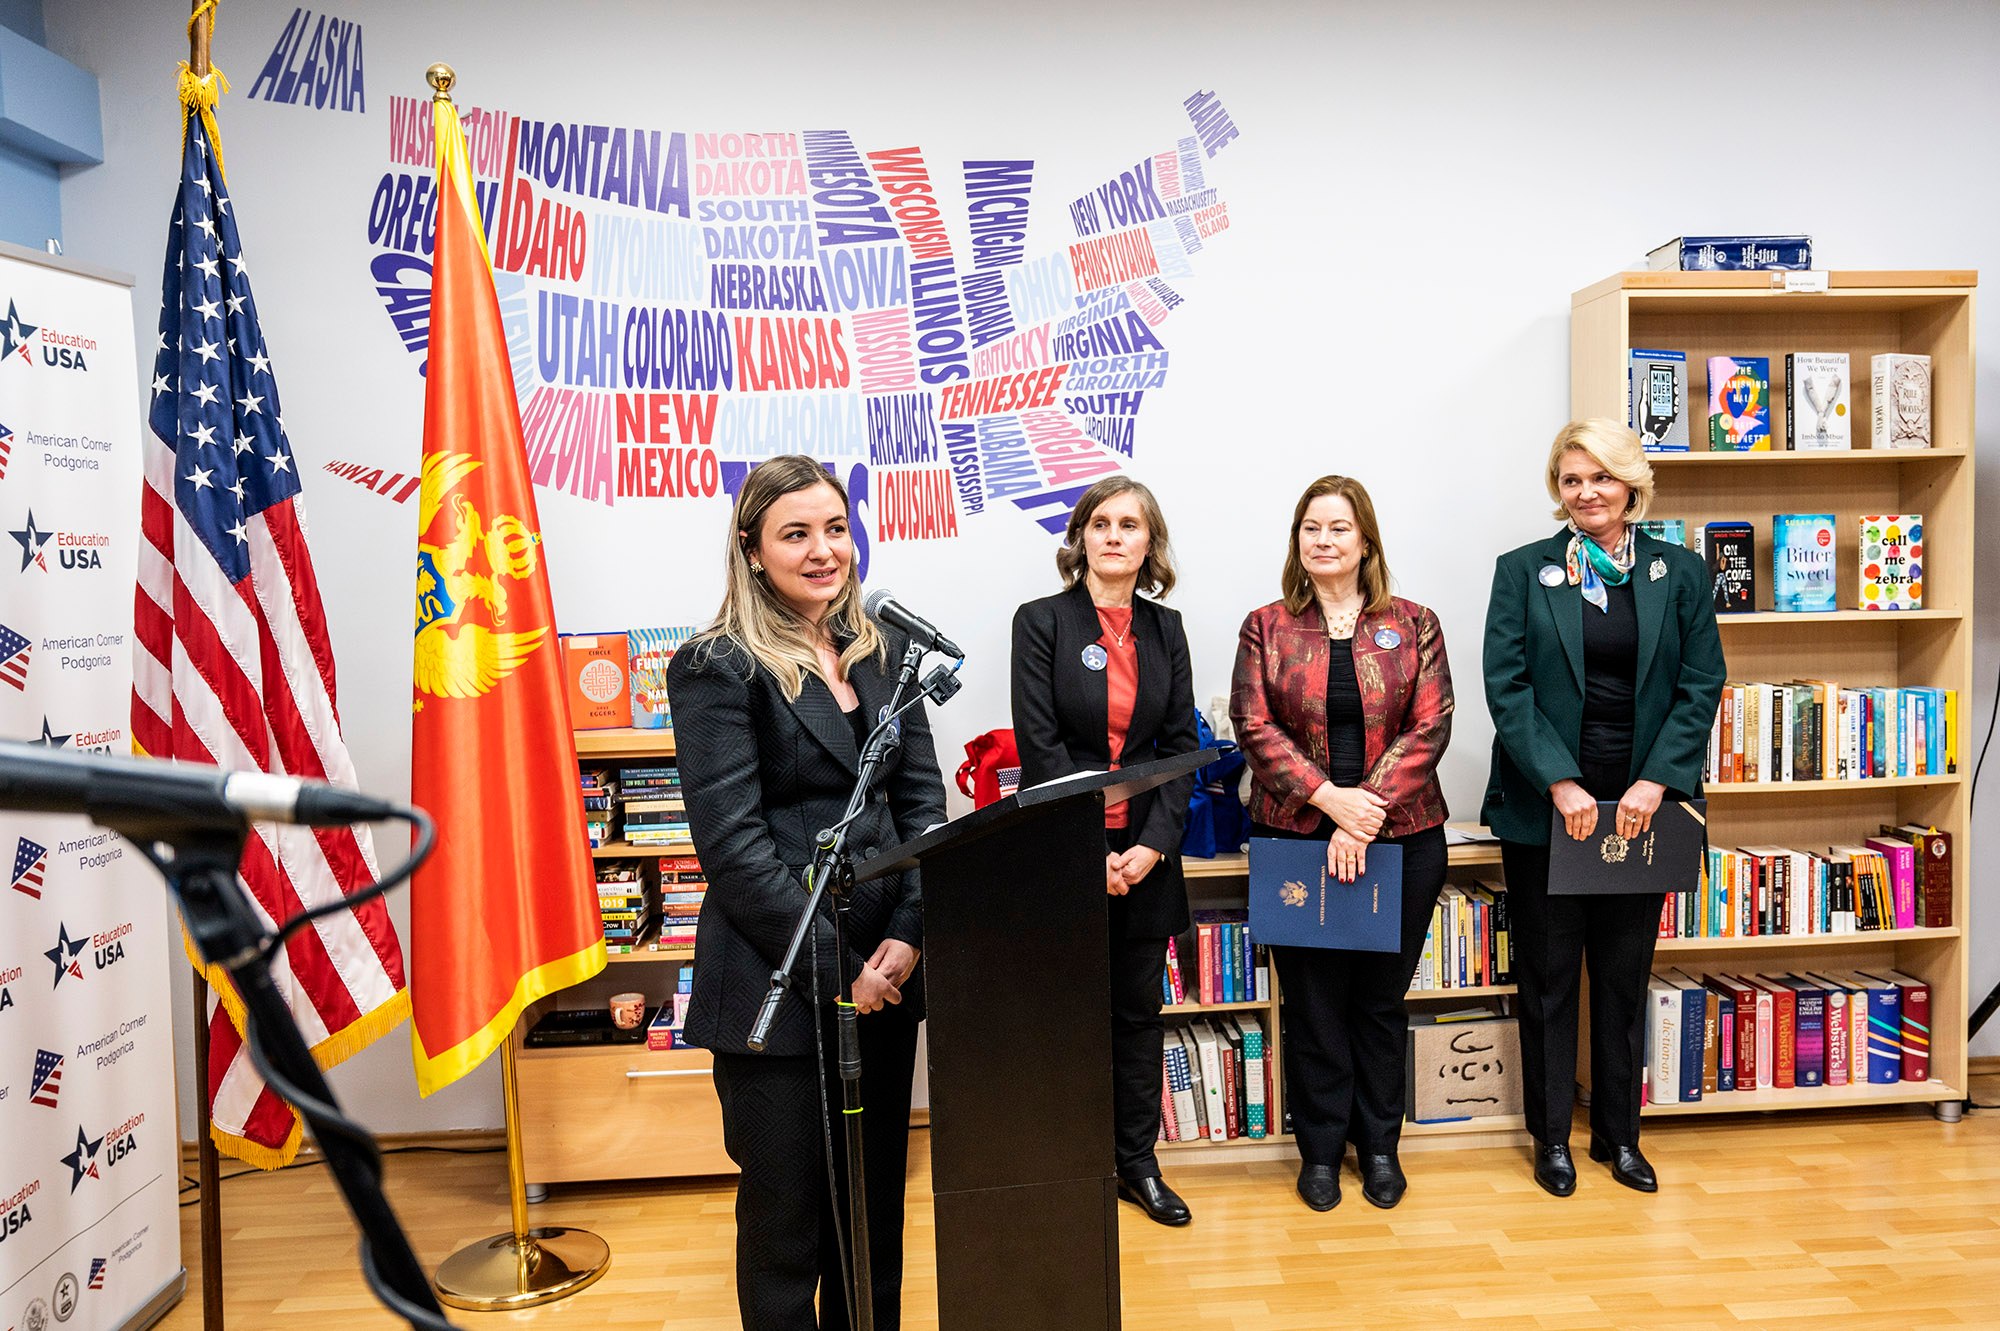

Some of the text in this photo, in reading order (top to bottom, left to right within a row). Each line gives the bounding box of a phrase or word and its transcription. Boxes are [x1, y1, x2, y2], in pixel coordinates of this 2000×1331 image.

[247, 8, 365, 113] ALASKA
[1183, 89, 1240, 159] MAINE
[695, 133, 798, 159] NORTH
[519, 120, 691, 219] MONTANA
[695, 159, 807, 196] DAKOTA
[1154, 150, 1181, 200] VERMONT
[495, 117, 586, 282] IDAHO
[803, 130, 900, 246] MINNESOTA
[866, 146, 953, 260] WISCONSIN
[1069, 157, 1167, 237] NEW YORK
[1166, 188, 1217, 216] MASSACHUSETTS
[368, 172, 498, 255] OREGN
[698, 200, 809, 221] SOUTH
[963, 160, 1034, 269] MICHIGAN
[1193, 202, 1227, 225] RHODE
[1198, 215, 1230, 240] ISLAND
[591, 212, 704, 303] WYOMING
[703, 224, 815, 260] DAKOTA
[1069, 227, 1160, 293] PENNSYLVANIA
[711, 264, 829, 311] NEBRASKA
[818, 246, 908, 313] IOWA
[1009, 251, 1073, 325] OHIO
[1075, 285, 1121, 309] WEST
[1146, 277, 1184, 310] DELAWARE
[909, 258, 970, 384] ILLINOIS
[961, 270, 1016, 349] INDIANA
[1057, 291, 1130, 336] VIRGINIA
[1125, 281, 1168, 327] MARYLAND
[41, 328, 97, 351] Education
[538, 290, 620, 389] UTAH
[623, 306, 733, 391] COLORADO
[852, 308, 917, 394] MISSOURI
[974, 322, 1050, 378] KENTUCKY
[1053, 310, 1165, 362] VIRGINIA
[43, 345, 88, 372] USA
[734, 316, 850, 392] KANSAS
[1070, 352, 1168, 376] NORTH
[1736, 366, 1751, 375] THE
[1815, 356, 1847, 364] Beautiful
[939, 364, 1069, 420] TENNESSEE
[1066, 370, 1167, 391] CAROLINA
[1653, 372, 1670, 381] MIND
[1653, 384, 1670, 394] OVER
[1720, 380, 1768, 389] VANISHING
[1903, 388, 1917, 398] RULE
[1064, 391, 1143, 415] SOUTH
[1733, 394, 1754, 402] HALF
[616, 394, 719, 444] NEW
[720, 393, 865, 456] OKLAHOMA
[867, 392, 938, 466] ARKANSAS
[27, 431, 112, 452] American Corner
[520, 386, 614, 507] ARIZONA
[1021, 410, 1122, 486] GEORGIA
[1085, 418, 1135, 458] CAROLINA
[1725, 434, 1764, 443] BENNETT
[44, 453, 99, 471] Podgorica
[617, 448, 718, 498] MEXICO
[941, 423, 985, 516] MISSISSIPPI
[977, 415, 1042, 500] ALABAMA
[322, 460, 422, 504] HAWAII
[878, 469, 958, 542] LOUISIANA
[57, 532, 110, 547] Education
[1724, 544, 1738, 556] ON
[1787, 547, 1831, 562] Bitter
[1882, 535, 1907, 546] call
[59, 549, 102, 569] USA
[1725, 569, 1752, 580] COME
[1729, 557, 1746, 568] THE
[1787, 568, 1830, 581] sweet
[1885, 556, 1905, 565] me
[1728, 582, 1741, 593] UP
[1875, 573, 1914, 584] zebra
[42, 633, 123, 651] American Corner
[61, 654, 111, 671] Podgorica
[76, 728, 121, 747] Education
[58, 833, 108, 855] American
[79, 847, 122, 870] Podgorica
[599, 898, 625, 908] 2019
[93, 922, 133, 949] Education
[95, 941, 124, 969] USA
[77, 1013, 147, 1058] American Corner
[1780, 1013, 1791, 1068] Webster's
[1830, 1008, 1842, 1069] Webster's
[1855, 1009, 1866, 1072] Thesaurus
[96, 1041, 134, 1070] Podgorica
[106, 1112, 145, 1147] Education
[107, 1133, 137, 1167] USA
